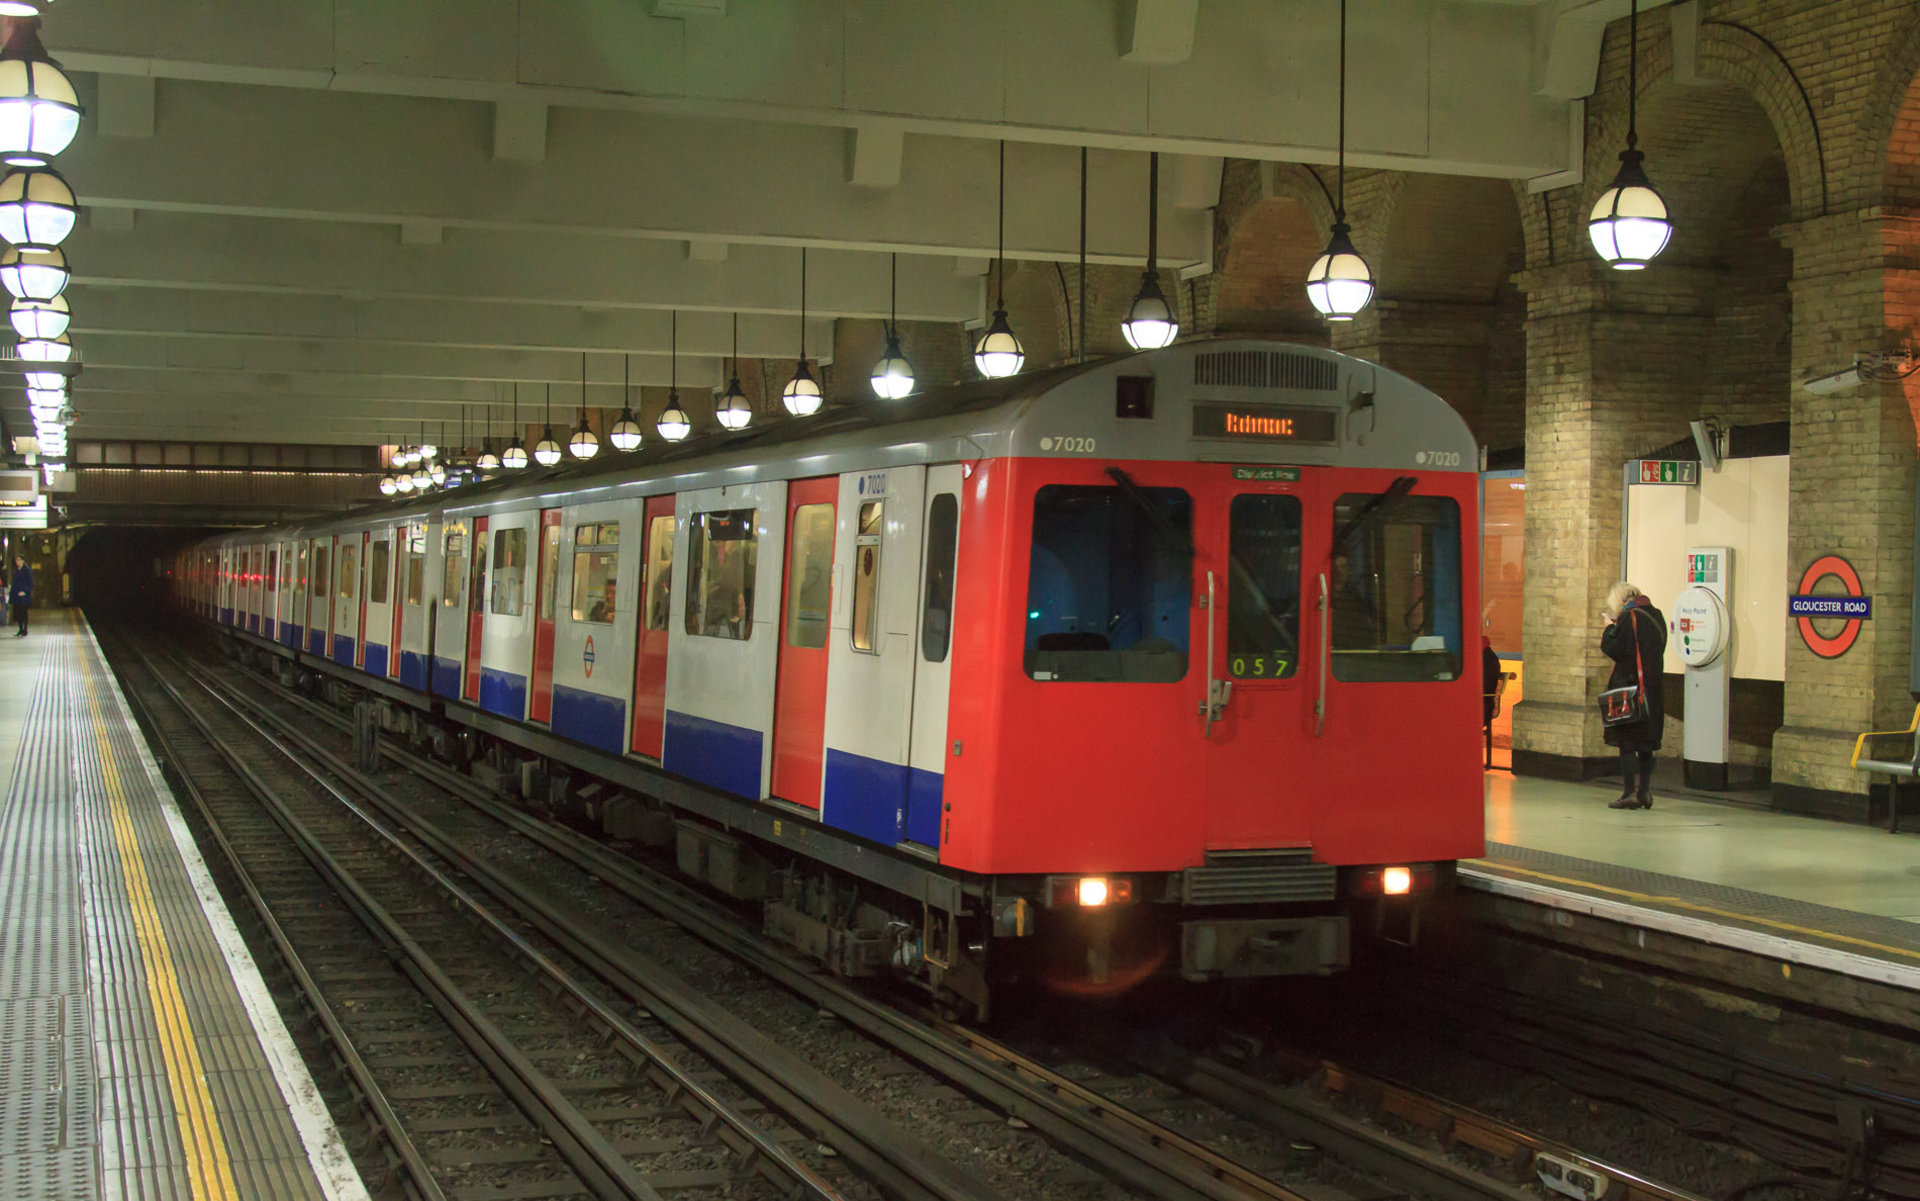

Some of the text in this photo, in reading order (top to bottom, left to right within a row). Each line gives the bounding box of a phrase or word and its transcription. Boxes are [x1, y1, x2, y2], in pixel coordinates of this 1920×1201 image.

[1053, 436, 1096, 453] 7020
[1426, 450, 1460, 466] 7020
[867, 473, 886, 495] 7020
[1793, 600, 1867, 613] GLOUCESTER ROAD
